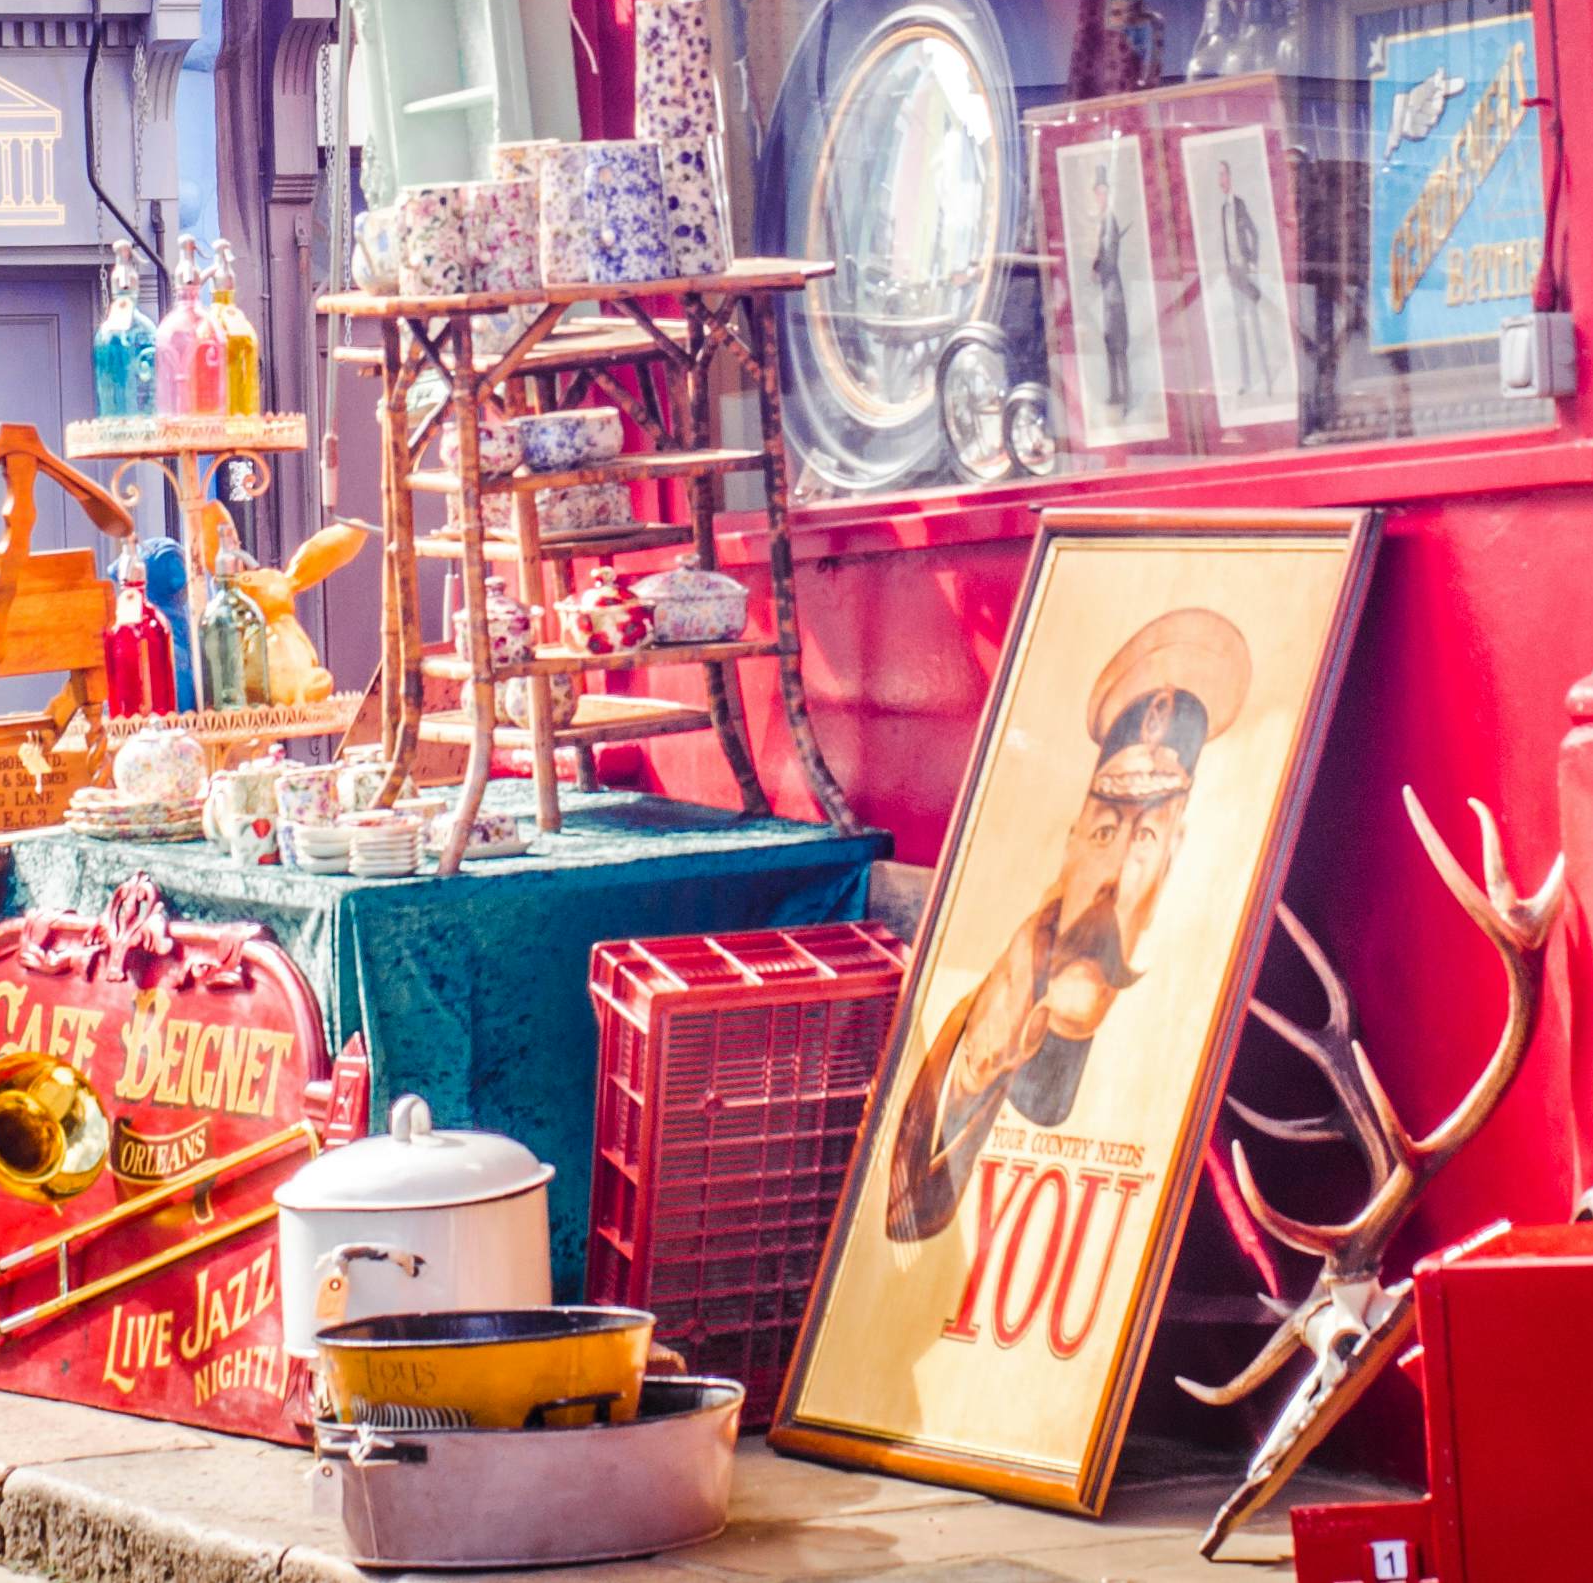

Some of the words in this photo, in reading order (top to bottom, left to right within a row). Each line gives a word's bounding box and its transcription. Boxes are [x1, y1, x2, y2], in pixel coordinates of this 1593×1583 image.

[1446, 236, 1542, 308] BATHS
[2, 773, 11, 787] &
[16, 771, 69, 787] SASMEN
[14, 791, 55, 807] LANE
[115, 987, 295, 1117] BEIGNET
[121, 1128, 207, 1176] ORLEANS
[1031, 1132, 1094, 1160] COUNTRY
[1096, 1141, 1146, 1168] NEEDS
[103, 1305, 174, 1395] LIVE
[180, 1248, 275, 1360] JAZZ
[1383, 1550, 1397, 1577] 1
